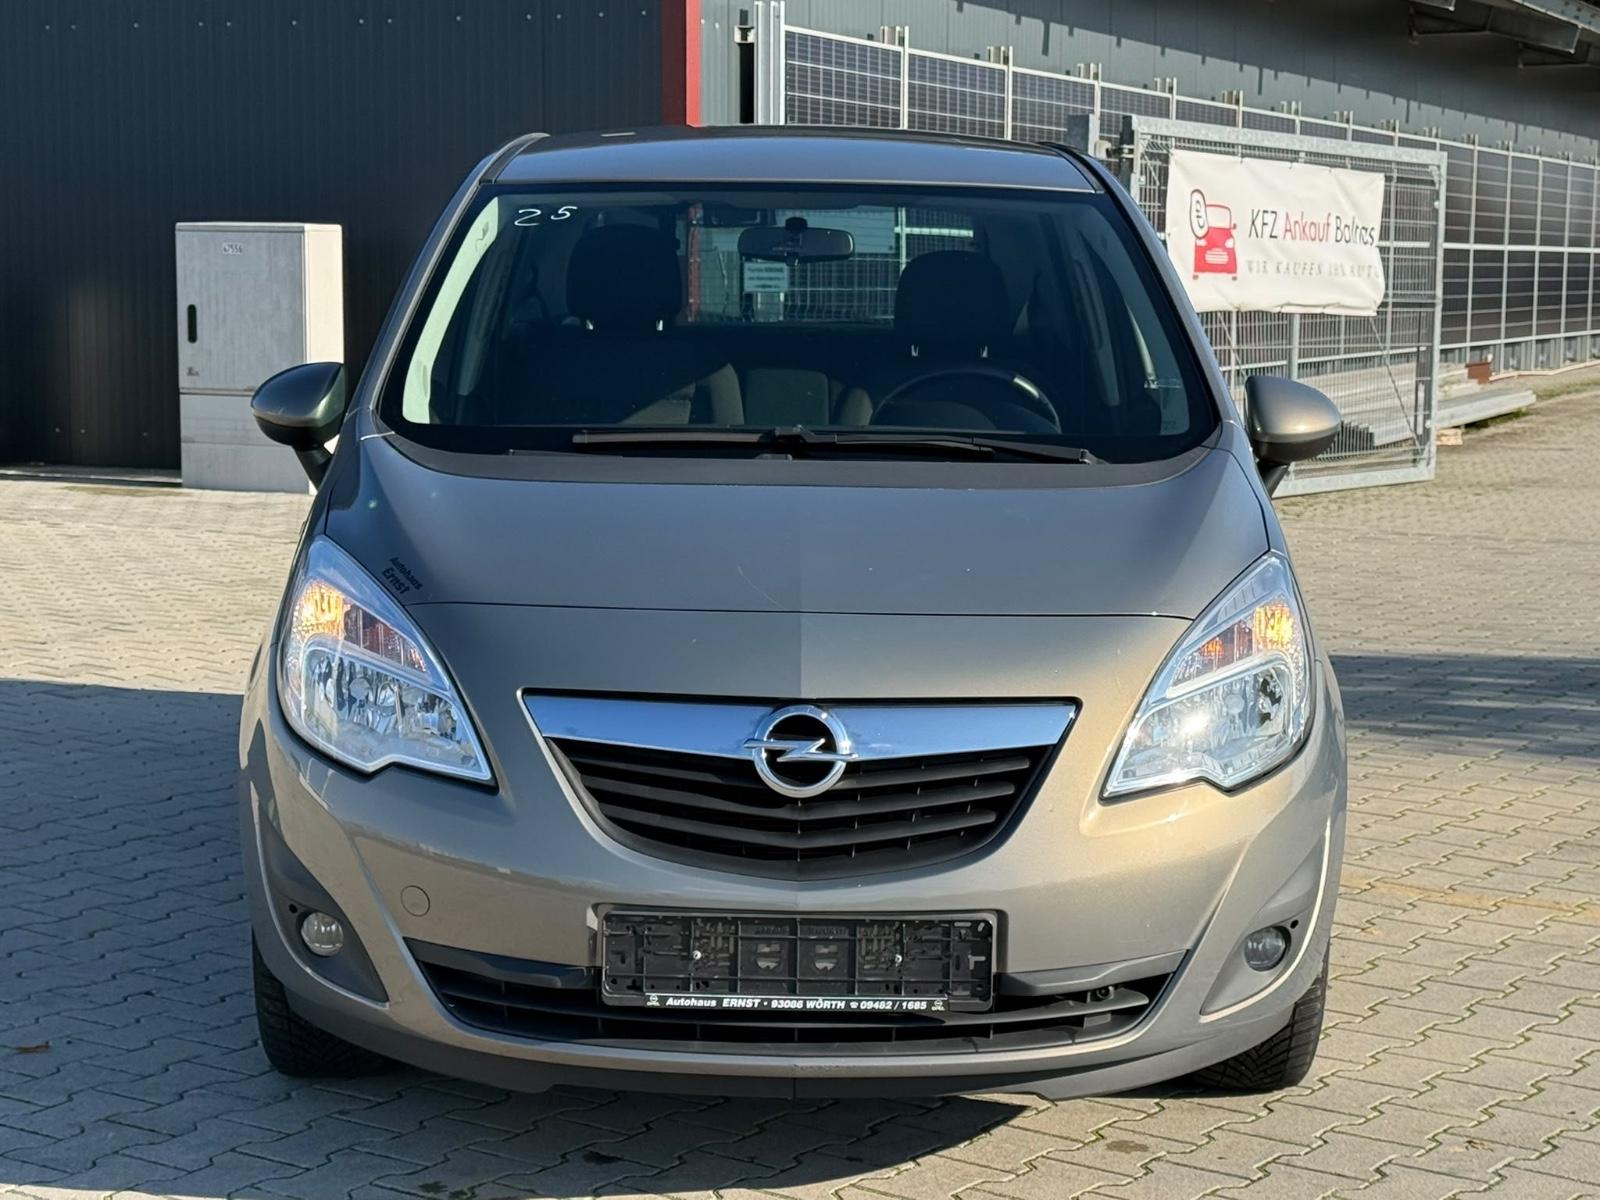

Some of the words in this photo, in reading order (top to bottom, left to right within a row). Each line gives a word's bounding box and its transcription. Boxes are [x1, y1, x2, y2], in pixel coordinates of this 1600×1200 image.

[1248, 208, 1279, 239] KFZ
[1283, 211, 1331, 242] Ankauf
[1275, 260, 1323, 277] KAUFEN
[382, 567, 410, 594] Ernst
[390, 557, 423, 590] Autohaus
[666, 997, 717, 1007] Autohaus
[722, 998, 761, 1008] ERNST
[771, 999, 803, 1009] 93086
[806, 998, 846, 1009] WÖRTH
[860, 1000, 892, 1010] 09482
[902, 1000, 927, 1010] 1685
